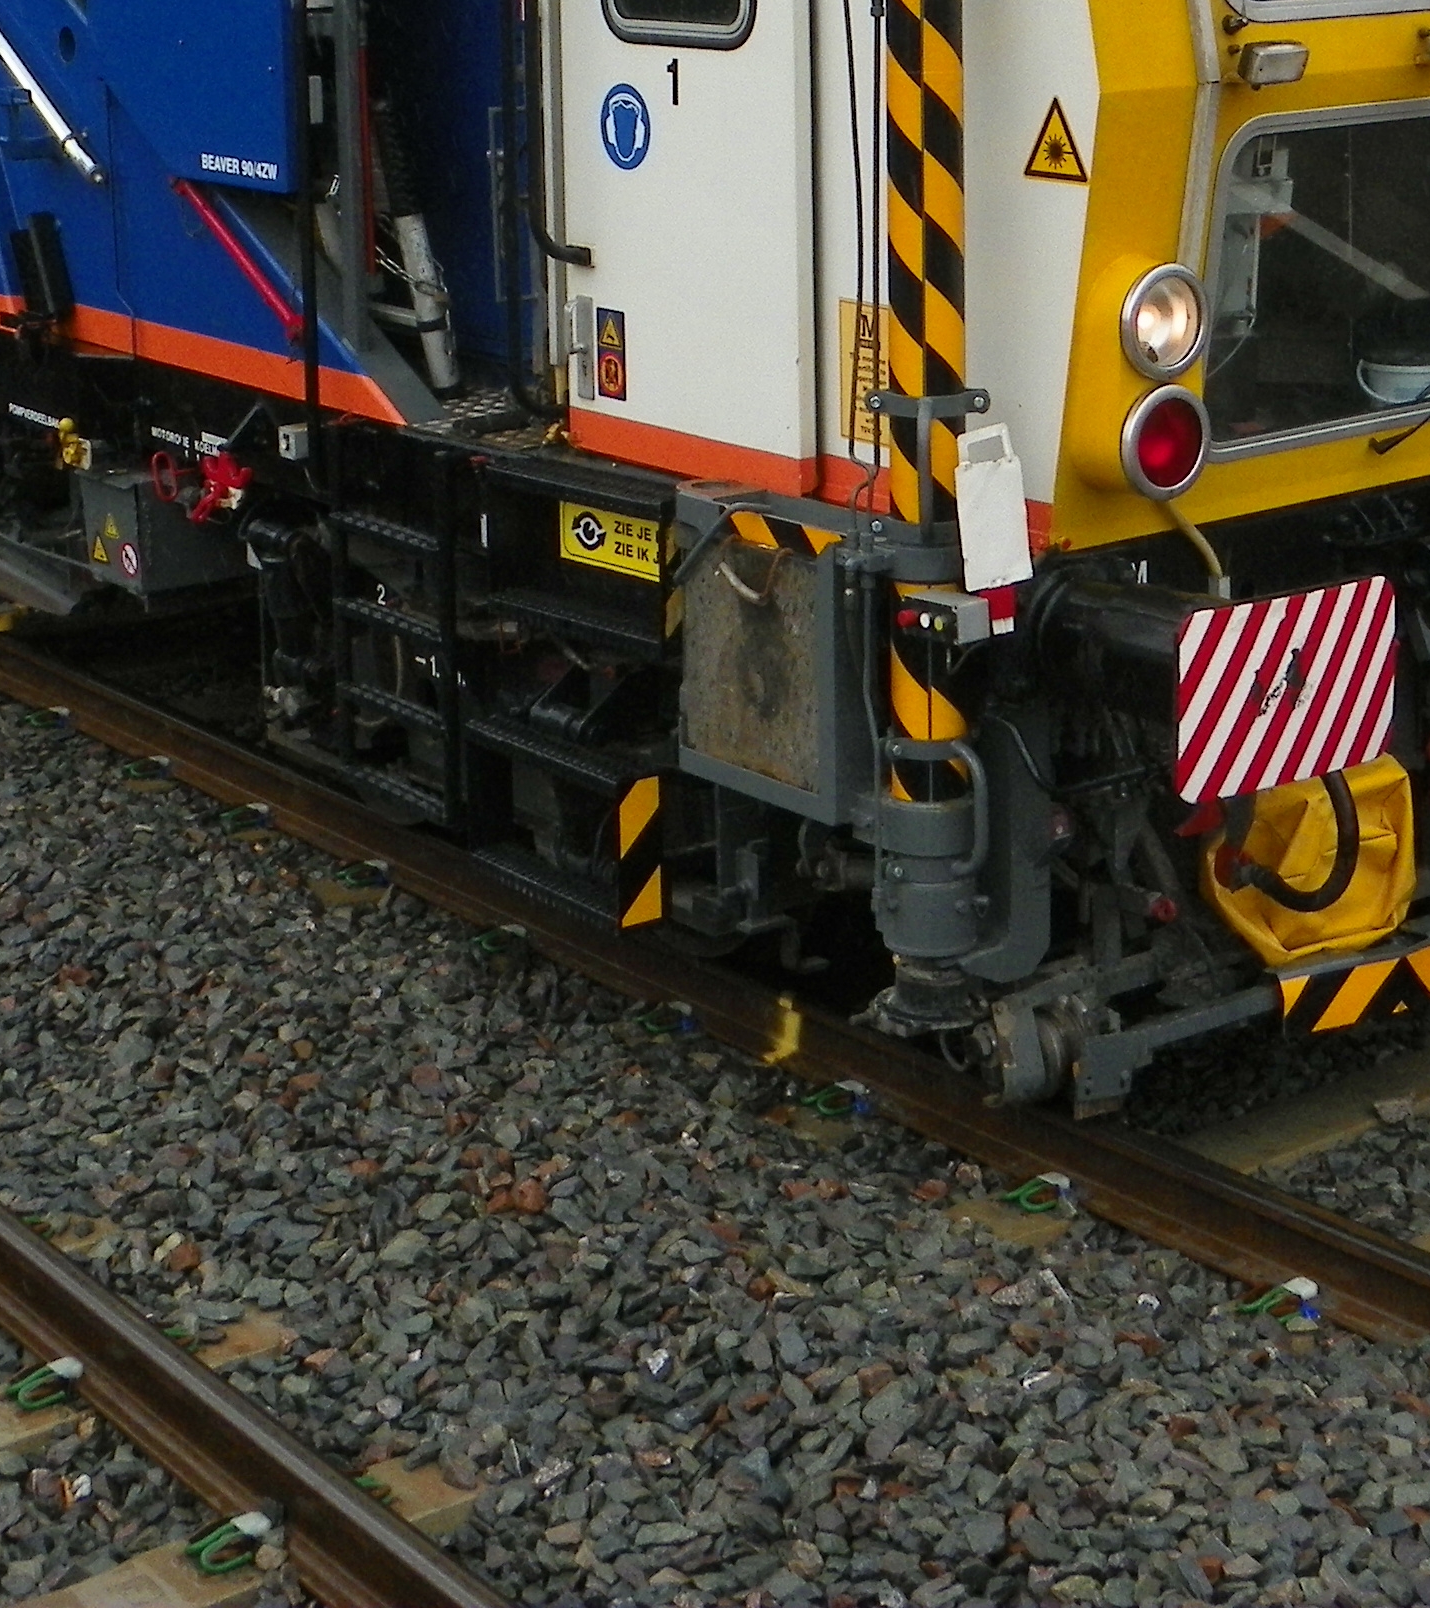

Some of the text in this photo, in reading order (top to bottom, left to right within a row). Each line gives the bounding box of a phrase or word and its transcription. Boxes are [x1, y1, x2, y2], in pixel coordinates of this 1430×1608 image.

[666, 58, 679, 106] 1
[201, 153, 240, 175] BEAVER
[614, 520, 633, 537] ZIE
[637, 526, 652, 541] JE
[614, 541, 633, 558] ZIE
[637, 547, 649, 561] IK
